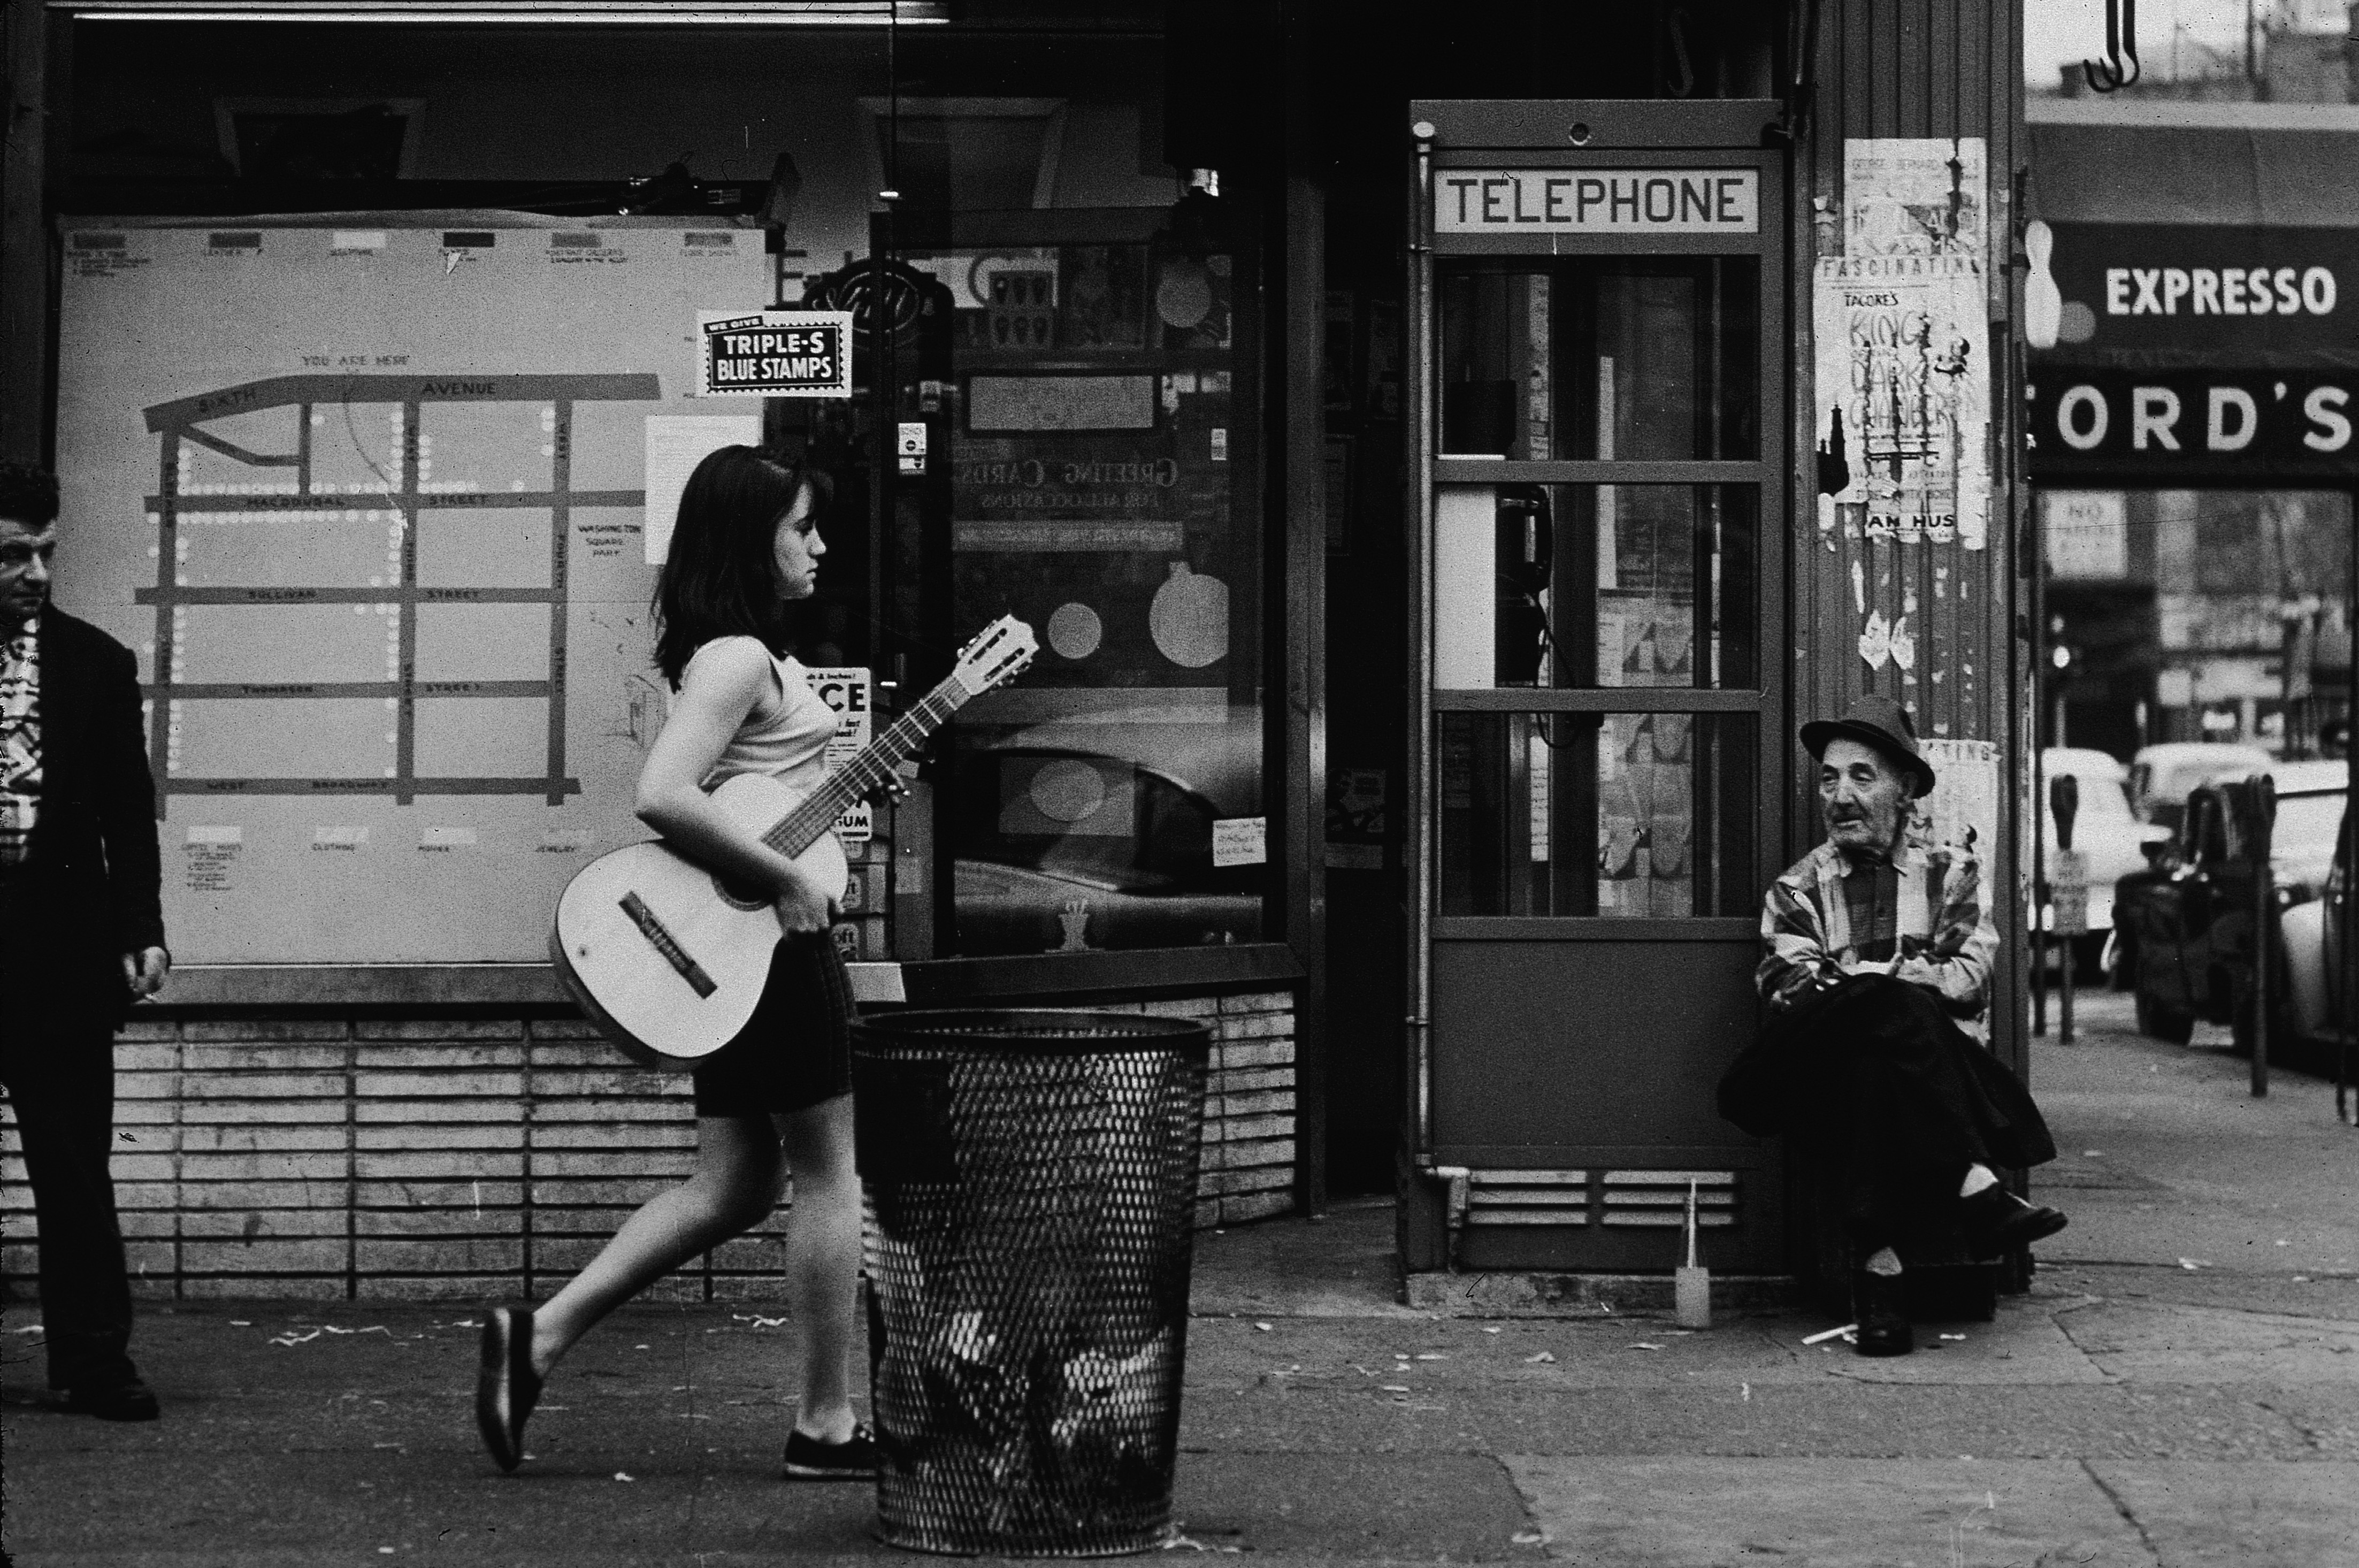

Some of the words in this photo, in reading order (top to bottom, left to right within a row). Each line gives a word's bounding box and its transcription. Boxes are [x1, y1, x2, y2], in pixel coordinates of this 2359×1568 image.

[1446, 178, 1745, 223] TELEPHONE
[1822, 258, 1981, 278] FASCINATIN
[2106, 266, 2338, 316] EXPRESSO
[708, 323, 727, 332] WE
[730, 318, 760, 328] GIVE
[723, 331, 825, 355] TRIPLE-S
[301, 355, 330, 366] YOU
[338, 355, 367, 366] ARE
[376, 355, 409, 366] HERE
[717, 358, 758, 381] BLUE
[761, 356, 832, 380] STAMPS
[420, 381, 497, 395] AVENUE
[2025, 381, 2352, 452] ORD'S
[429, 494, 489, 506] STREET
[1913, 514, 1955, 527] HUS
[427, 590, 479, 599] STREET
[808, 683, 866, 713] CE
[312, 780, 389, 790] BROADWAY
